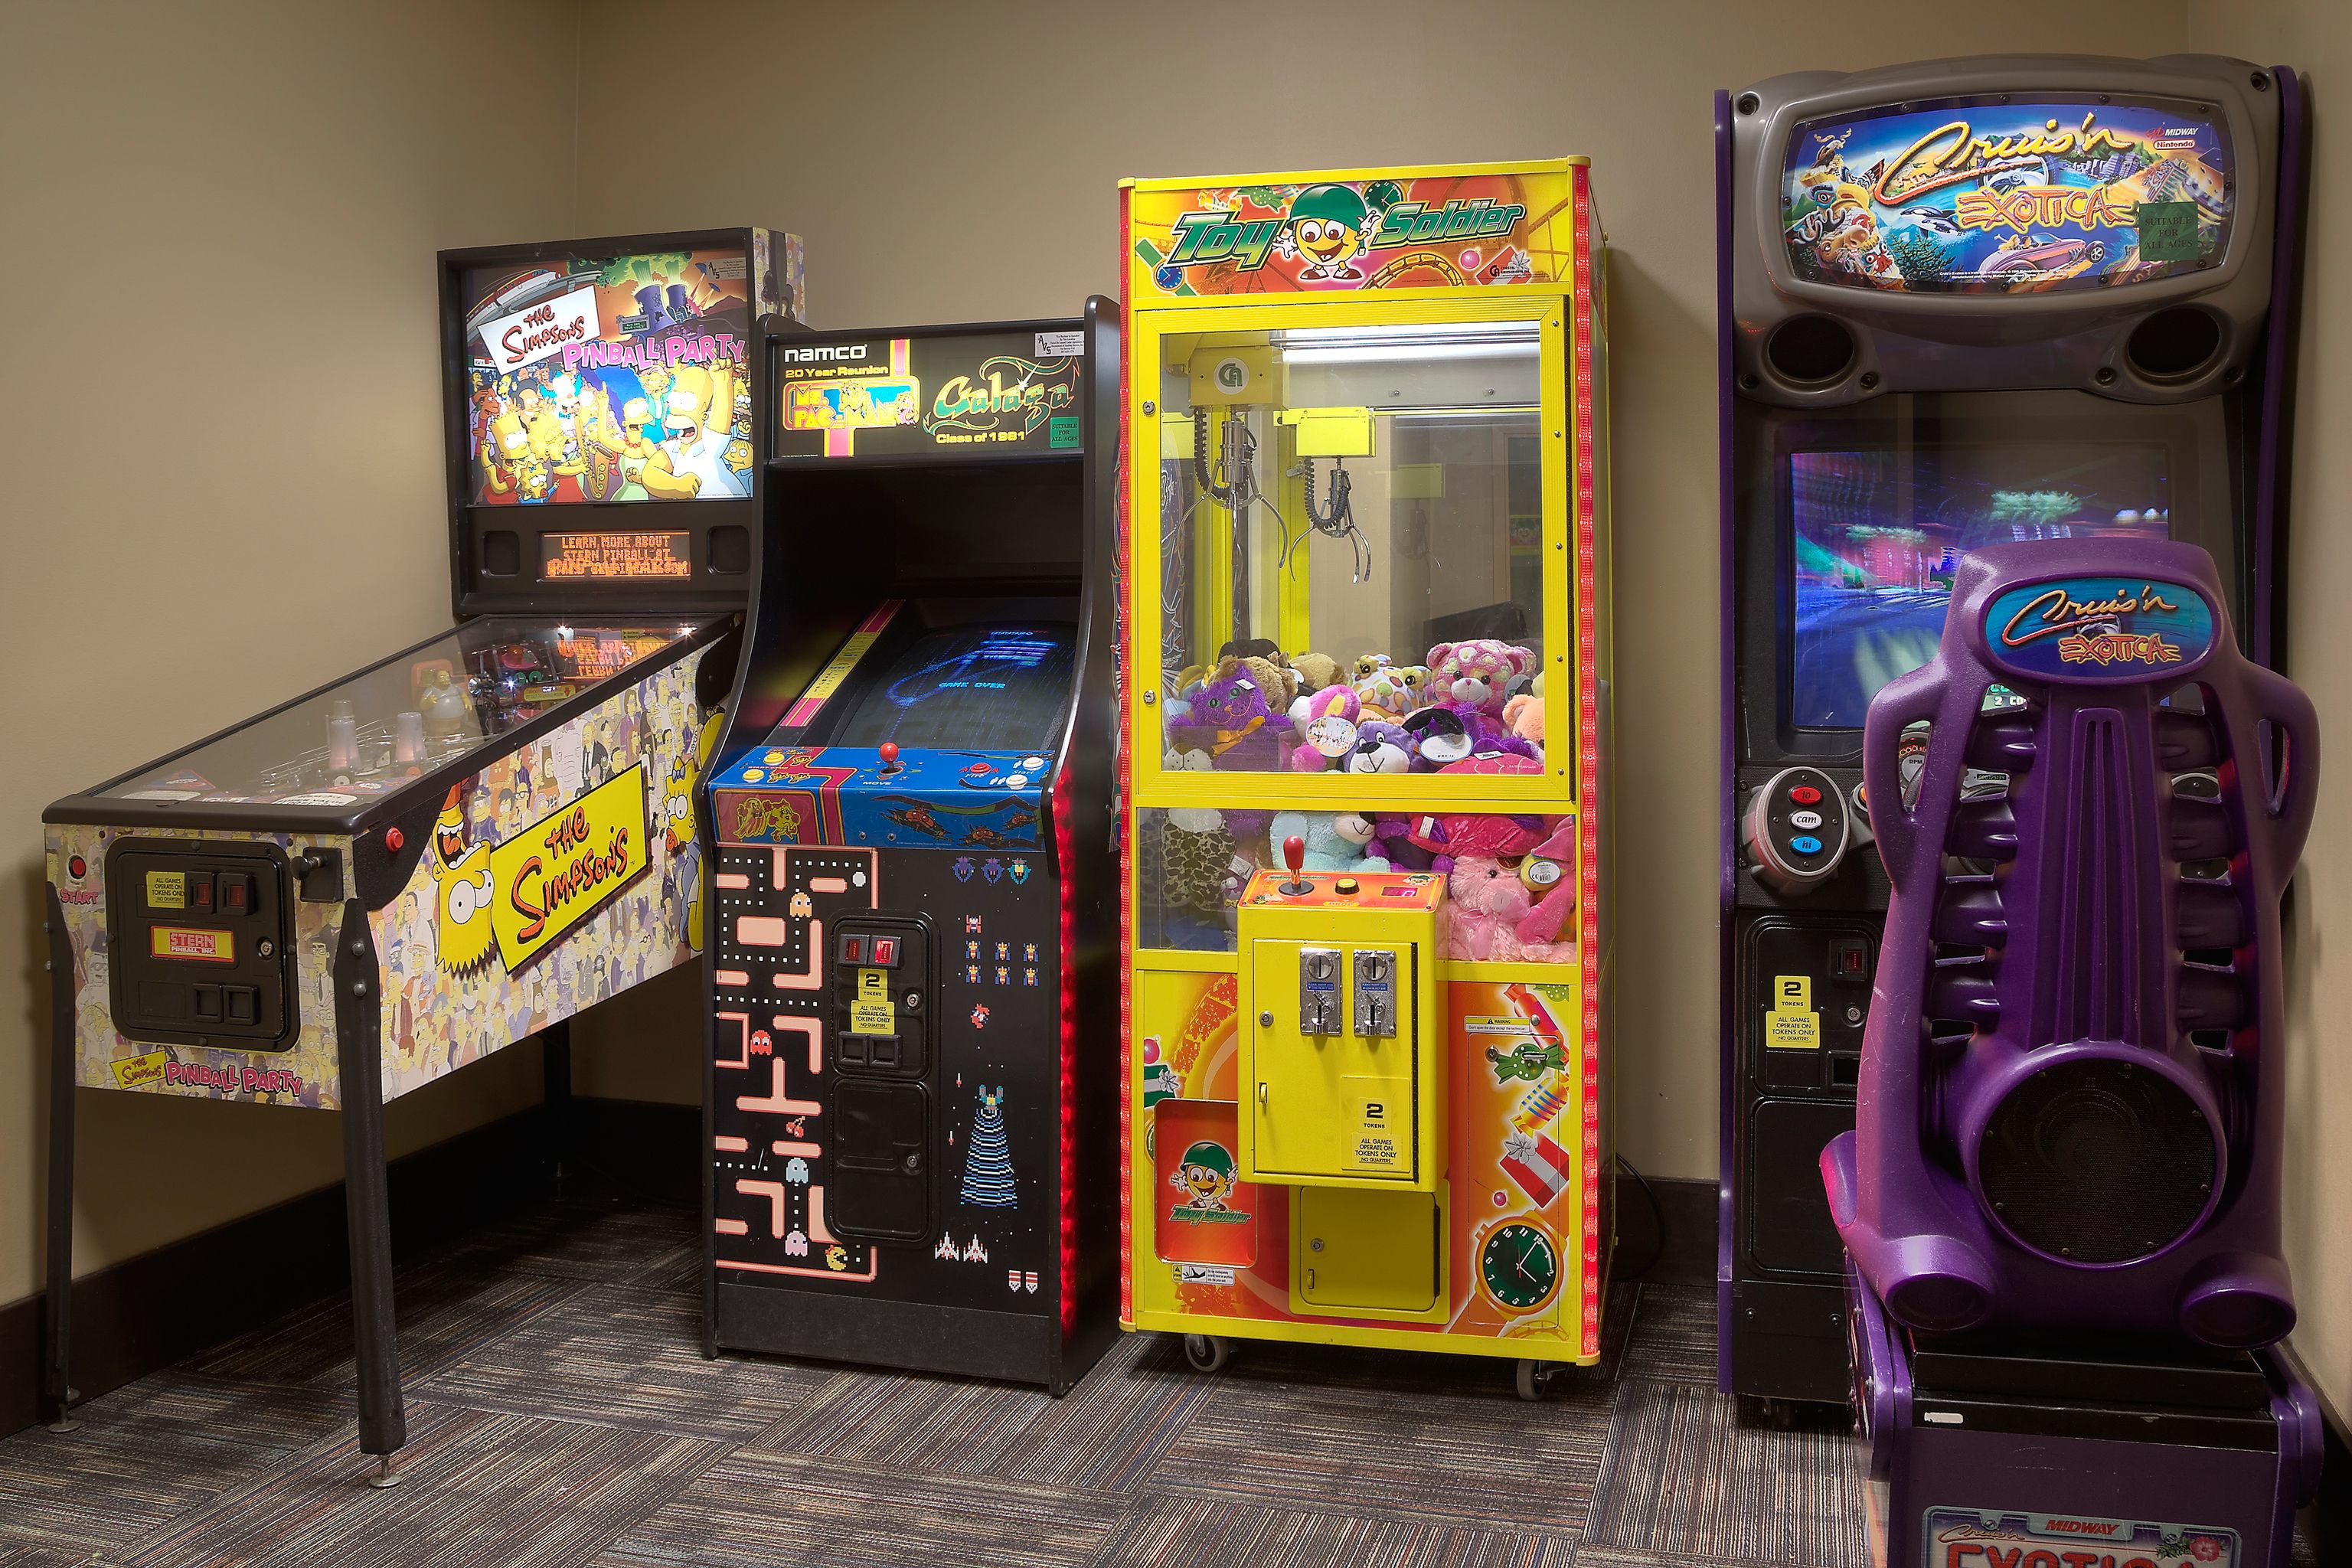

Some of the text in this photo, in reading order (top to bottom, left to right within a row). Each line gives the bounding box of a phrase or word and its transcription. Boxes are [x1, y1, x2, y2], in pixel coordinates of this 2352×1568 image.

[2164, 128, 2198, 136] MIDWAY
[1873, 112, 2134, 207] Cruis'n
[1957, 187, 2135, 233] EXOTICA
[2145, 217, 2191, 227] SUITABLE
[1167, 198, 1527, 271] Toy Soldier
[2159, 229, 2178, 237] FOR
[2145, 240, 2193, 250] ALL AGES
[502, 316, 585, 363] SIMPSONS
[561, 333, 746, 371] PINBALL PARTY
[785, 344, 867, 363] namco
[785, 365, 889, 379] 20 Year Reunion
[792, 402, 899, 429] PAC-MAN
[936, 430, 1026, 444] Class of 1981
[561, 535, 671, 549] LEARN MORE ABOUT
[563, 548, 671, 561] STERN PINBALL AT
[2002, 585, 2177, 646] Cruis'n
[2060, 635, 2181, 665] EXOTICA
[1994, 696, 2003, 706] 2
[1802, 790, 1811, 799] lo
[545, 805, 590, 859] THE
[1802, 840, 1811, 849] hi
[511, 828, 629, 944] SIMPSONS
[60, 888, 98, 904] START
[170, 933, 215, 947] STERN
[865, 973, 880, 987] 2
[1784, 982, 1802, 996] 2
[122, 1064, 162, 1085] SIMPSONS
[165, 1062, 302, 1096] PINBALL PARTY
[1366, 1103, 1383, 1119] 2
[1168, 1204, 1252, 1225] Toy Soldier
[1502, 1228, 1513, 1238] 10
[1519, 1227, 1528, 1237] 11
[1534, 1234, 1544, 1245] 12
[1547, 1269, 1554, 1277] 2
[1938, 1524, 2026, 1544] Cruis'n
[2045, 1519, 2120, 1536] MIDWAY
